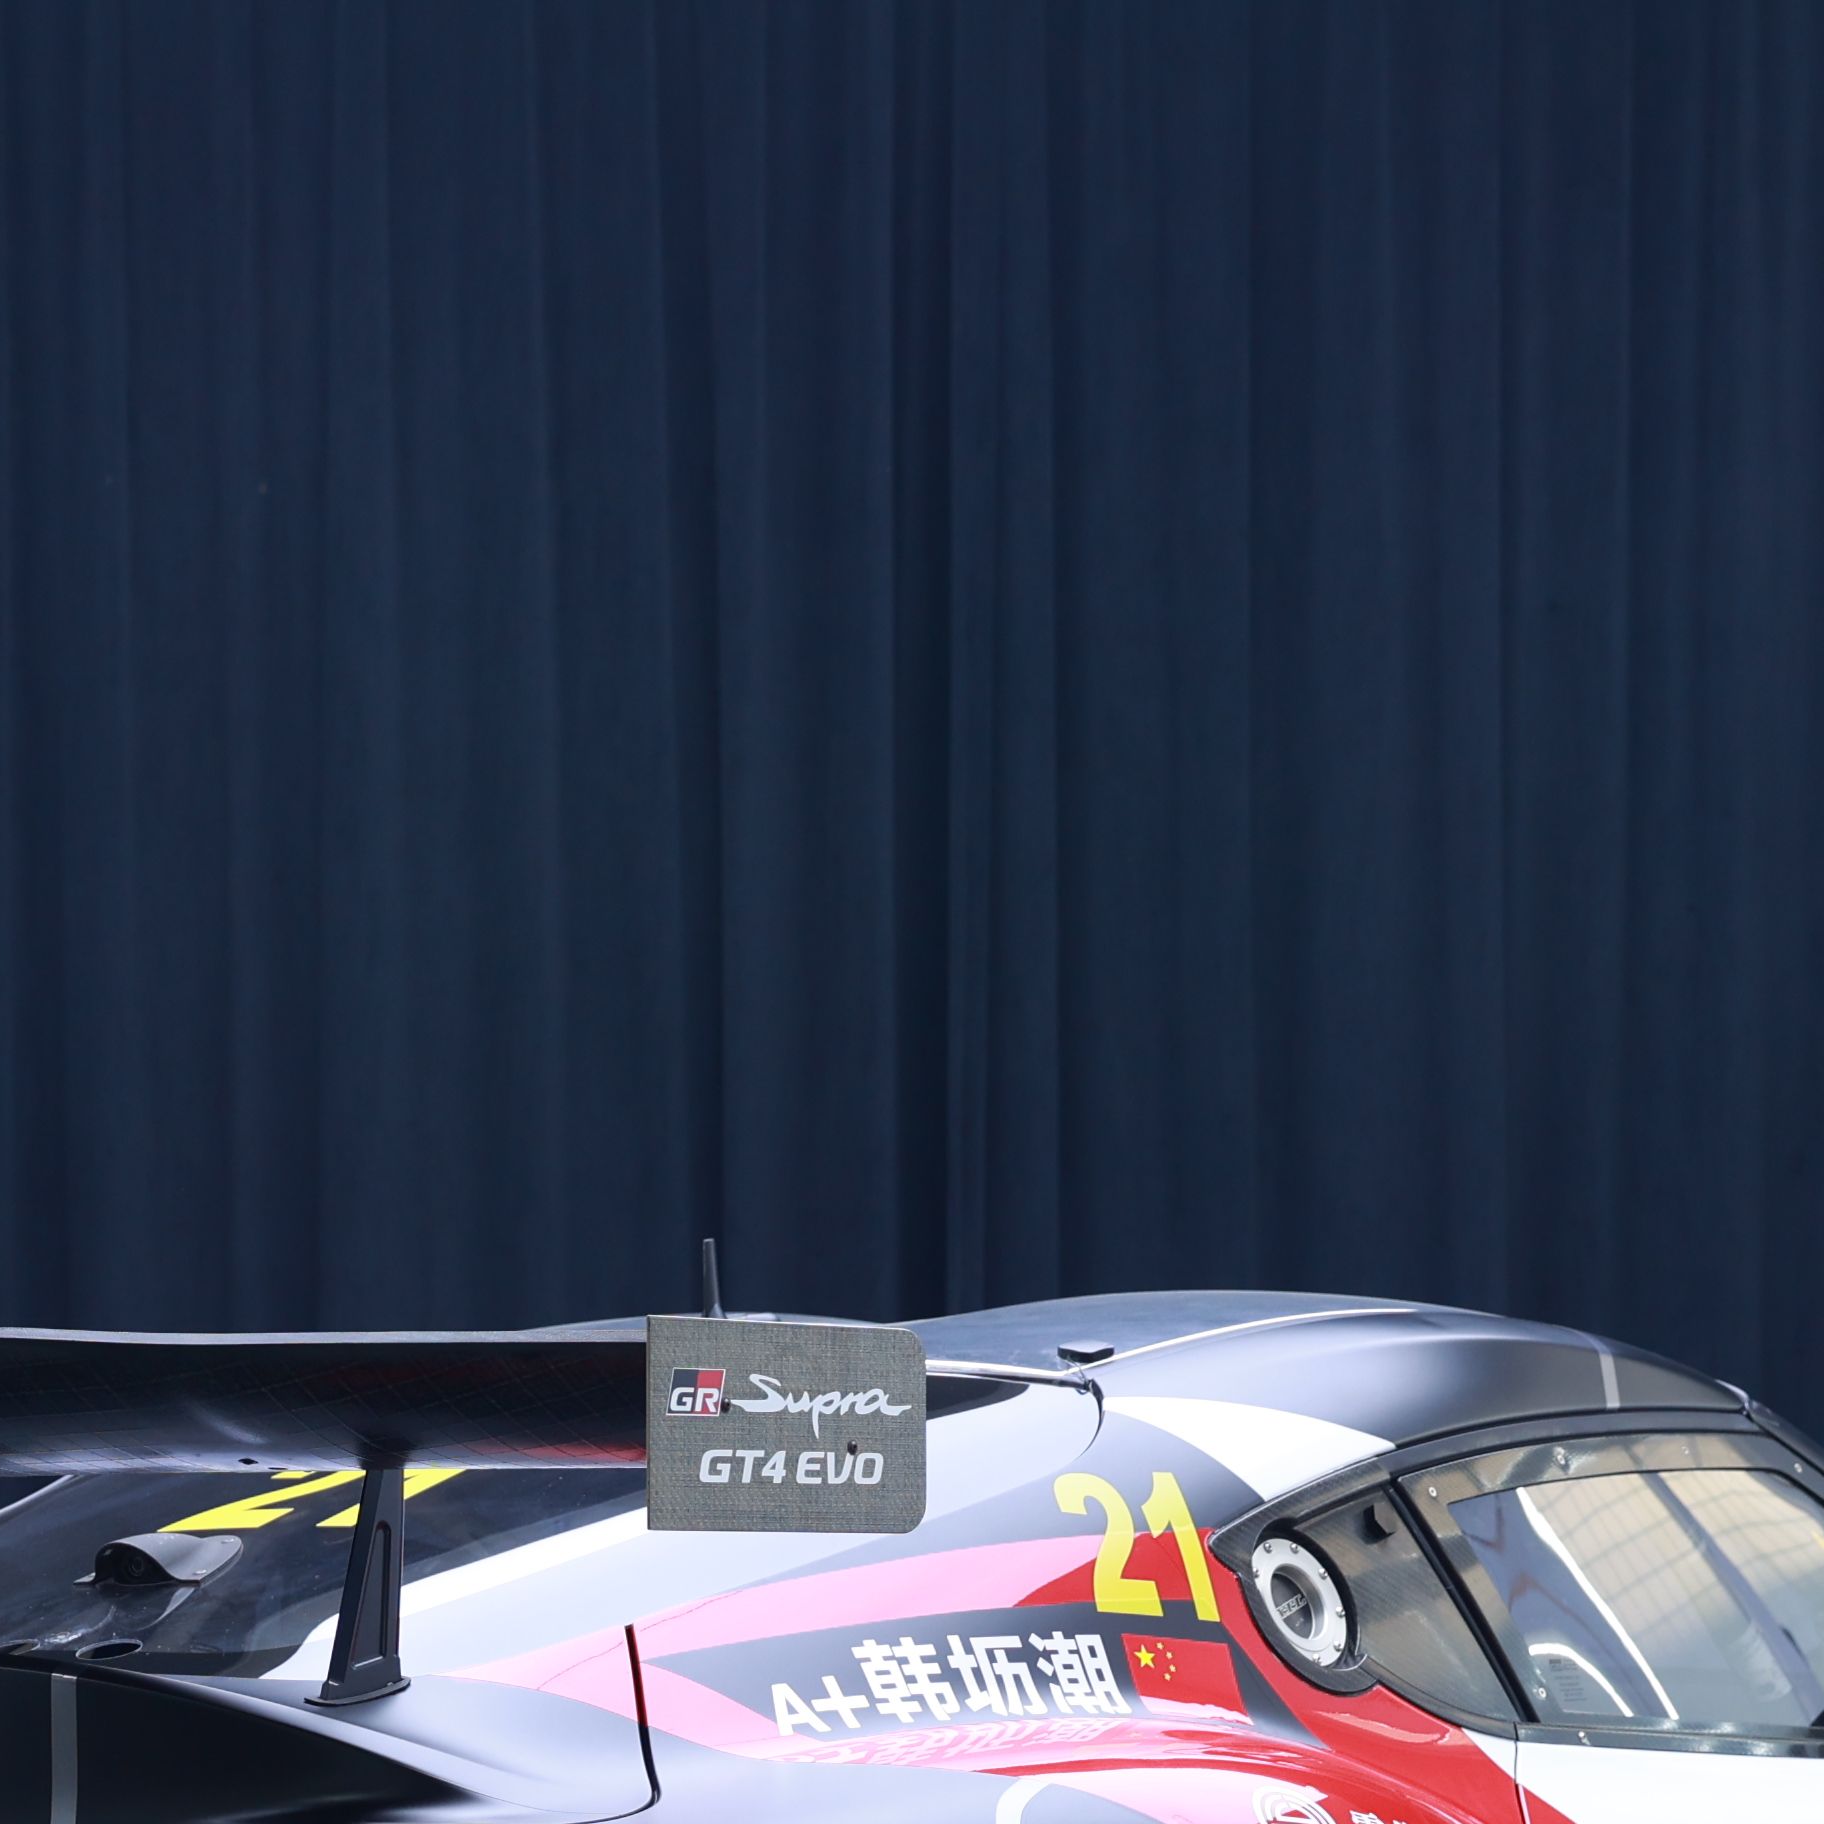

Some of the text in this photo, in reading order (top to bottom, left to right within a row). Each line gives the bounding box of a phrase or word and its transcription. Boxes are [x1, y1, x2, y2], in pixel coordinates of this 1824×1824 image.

[669, 1373, 912, 1438] GR Supra
[699, 1449, 883, 1485] GT4 EVO
[1053, 1471, 1221, 1623] 21
